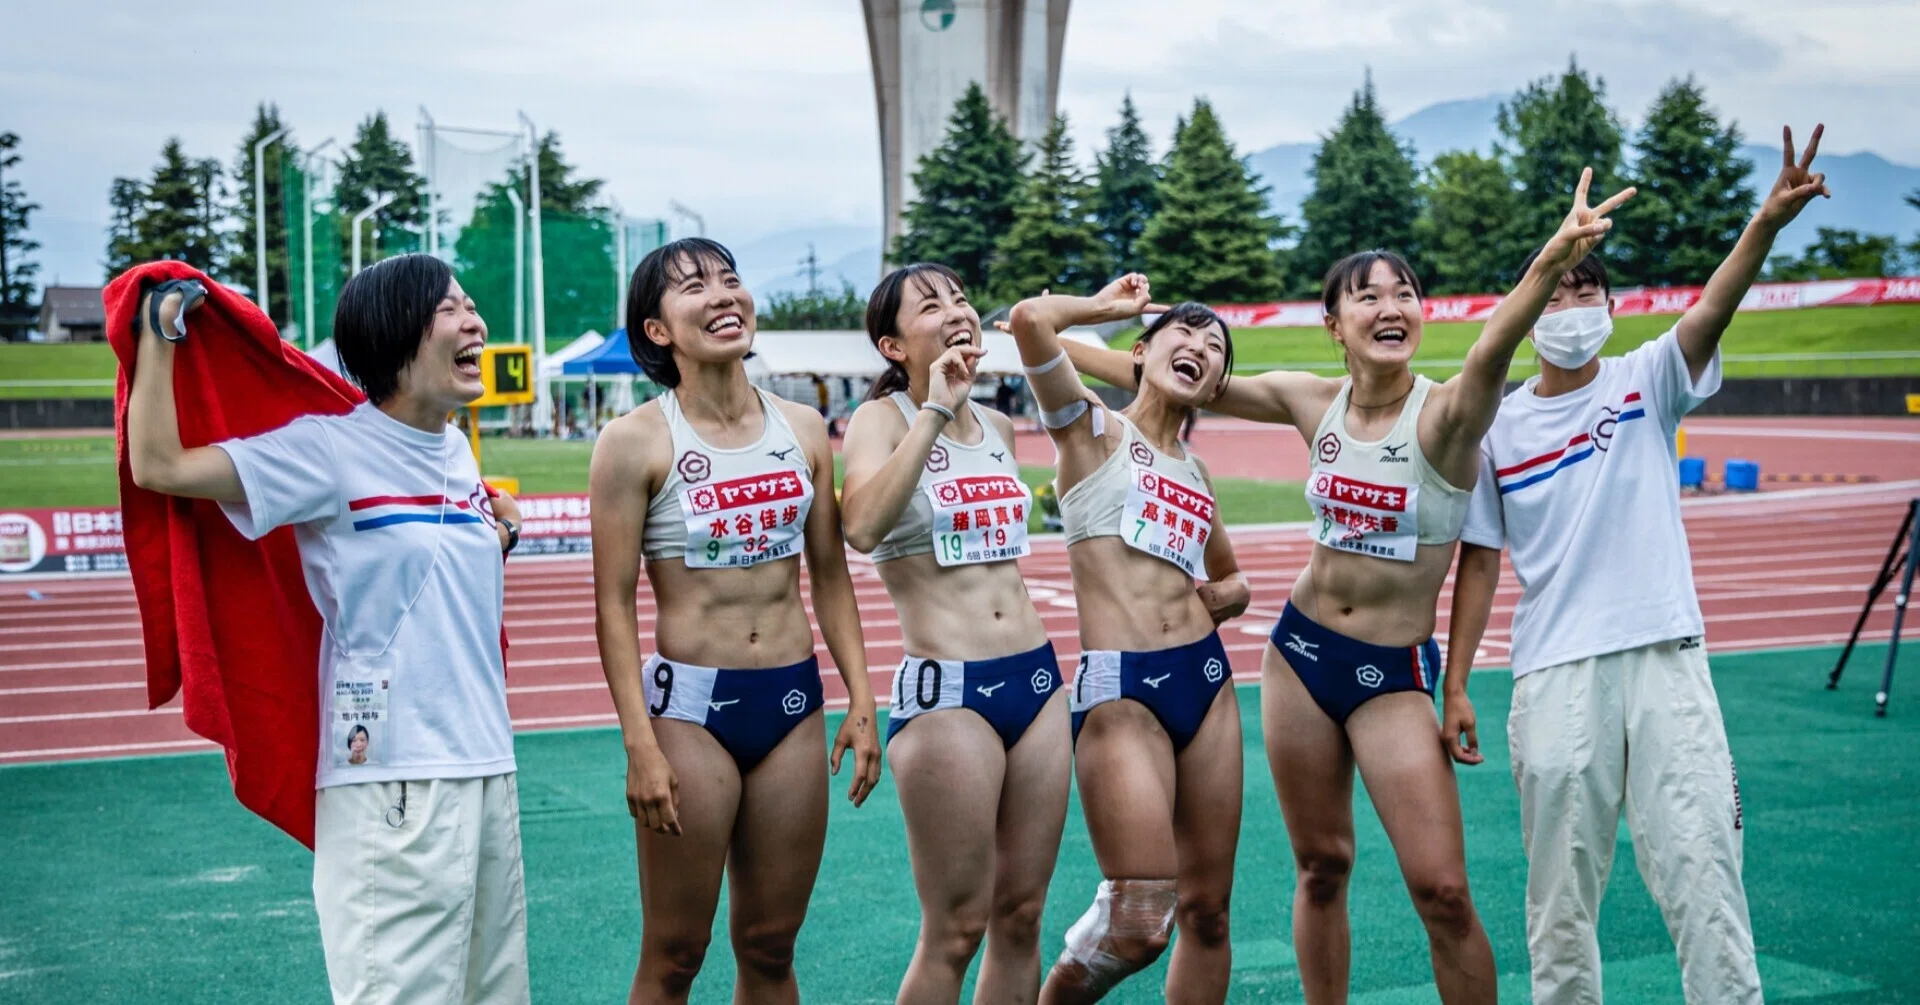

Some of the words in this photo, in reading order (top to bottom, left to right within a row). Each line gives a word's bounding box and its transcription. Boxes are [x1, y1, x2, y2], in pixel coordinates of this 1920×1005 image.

[507, 355, 524, 390] 4
[720, 476, 798, 503] ヤマザキ
[962, 480, 1019, 498] ヤマザキ
[1161, 482, 1214, 519] ヤマザキ
[1334, 481, 1402, 507] ヤマザキ
[709, 504, 798, 539] 水谷佳歩
[1135, 519, 1146, 543] 7
[1320, 519, 1332, 541] 8
[707, 540, 720, 561] 9
[744, 534, 768, 552] 32
[940, 533, 963, 561] 19
[982, 529, 1006, 548] 19
[1167, 532, 1185, 553] 20
[650, 662, 674, 716] 9
[898, 659, 942, 711] 10
